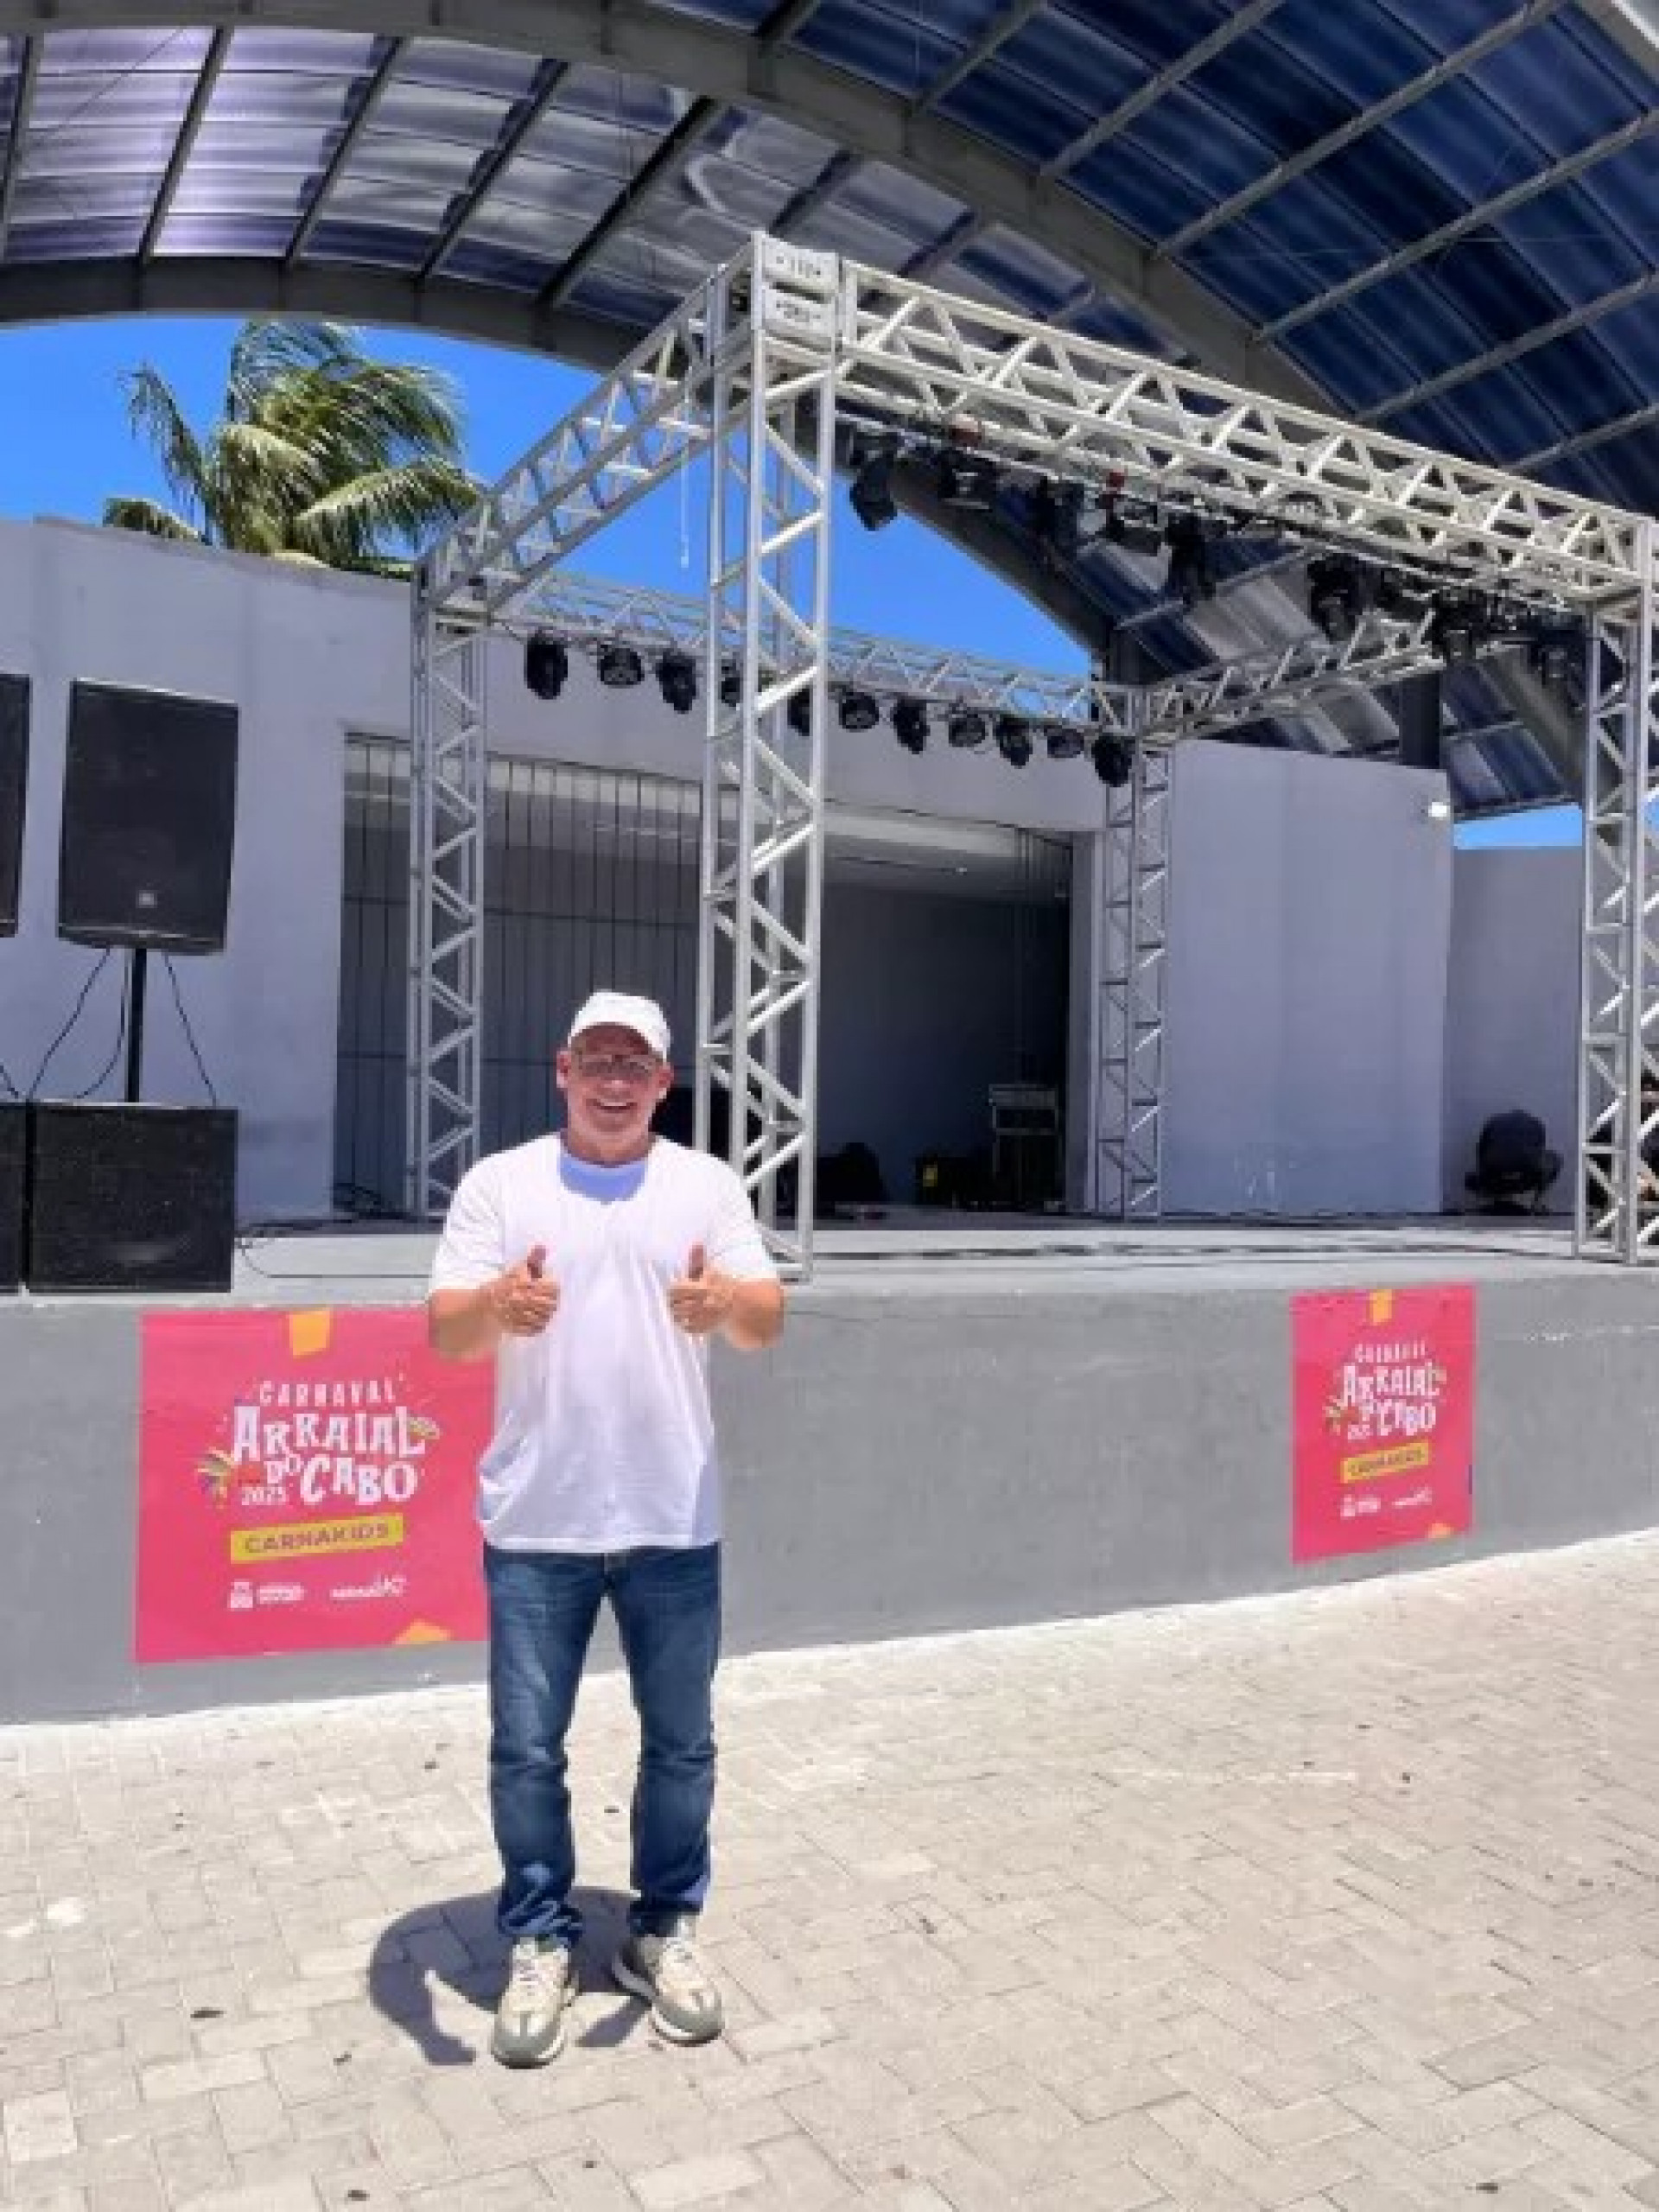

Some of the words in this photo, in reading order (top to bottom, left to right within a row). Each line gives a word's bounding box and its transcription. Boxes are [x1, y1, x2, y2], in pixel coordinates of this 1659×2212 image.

[259, 1377, 397, 1407] CARNAVAL
[232, 1405, 426, 1465] ARRAIAL
[299, 1455, 418, 1505] CABO
[244, 1521, 390, 1554] CARNAKIDS
